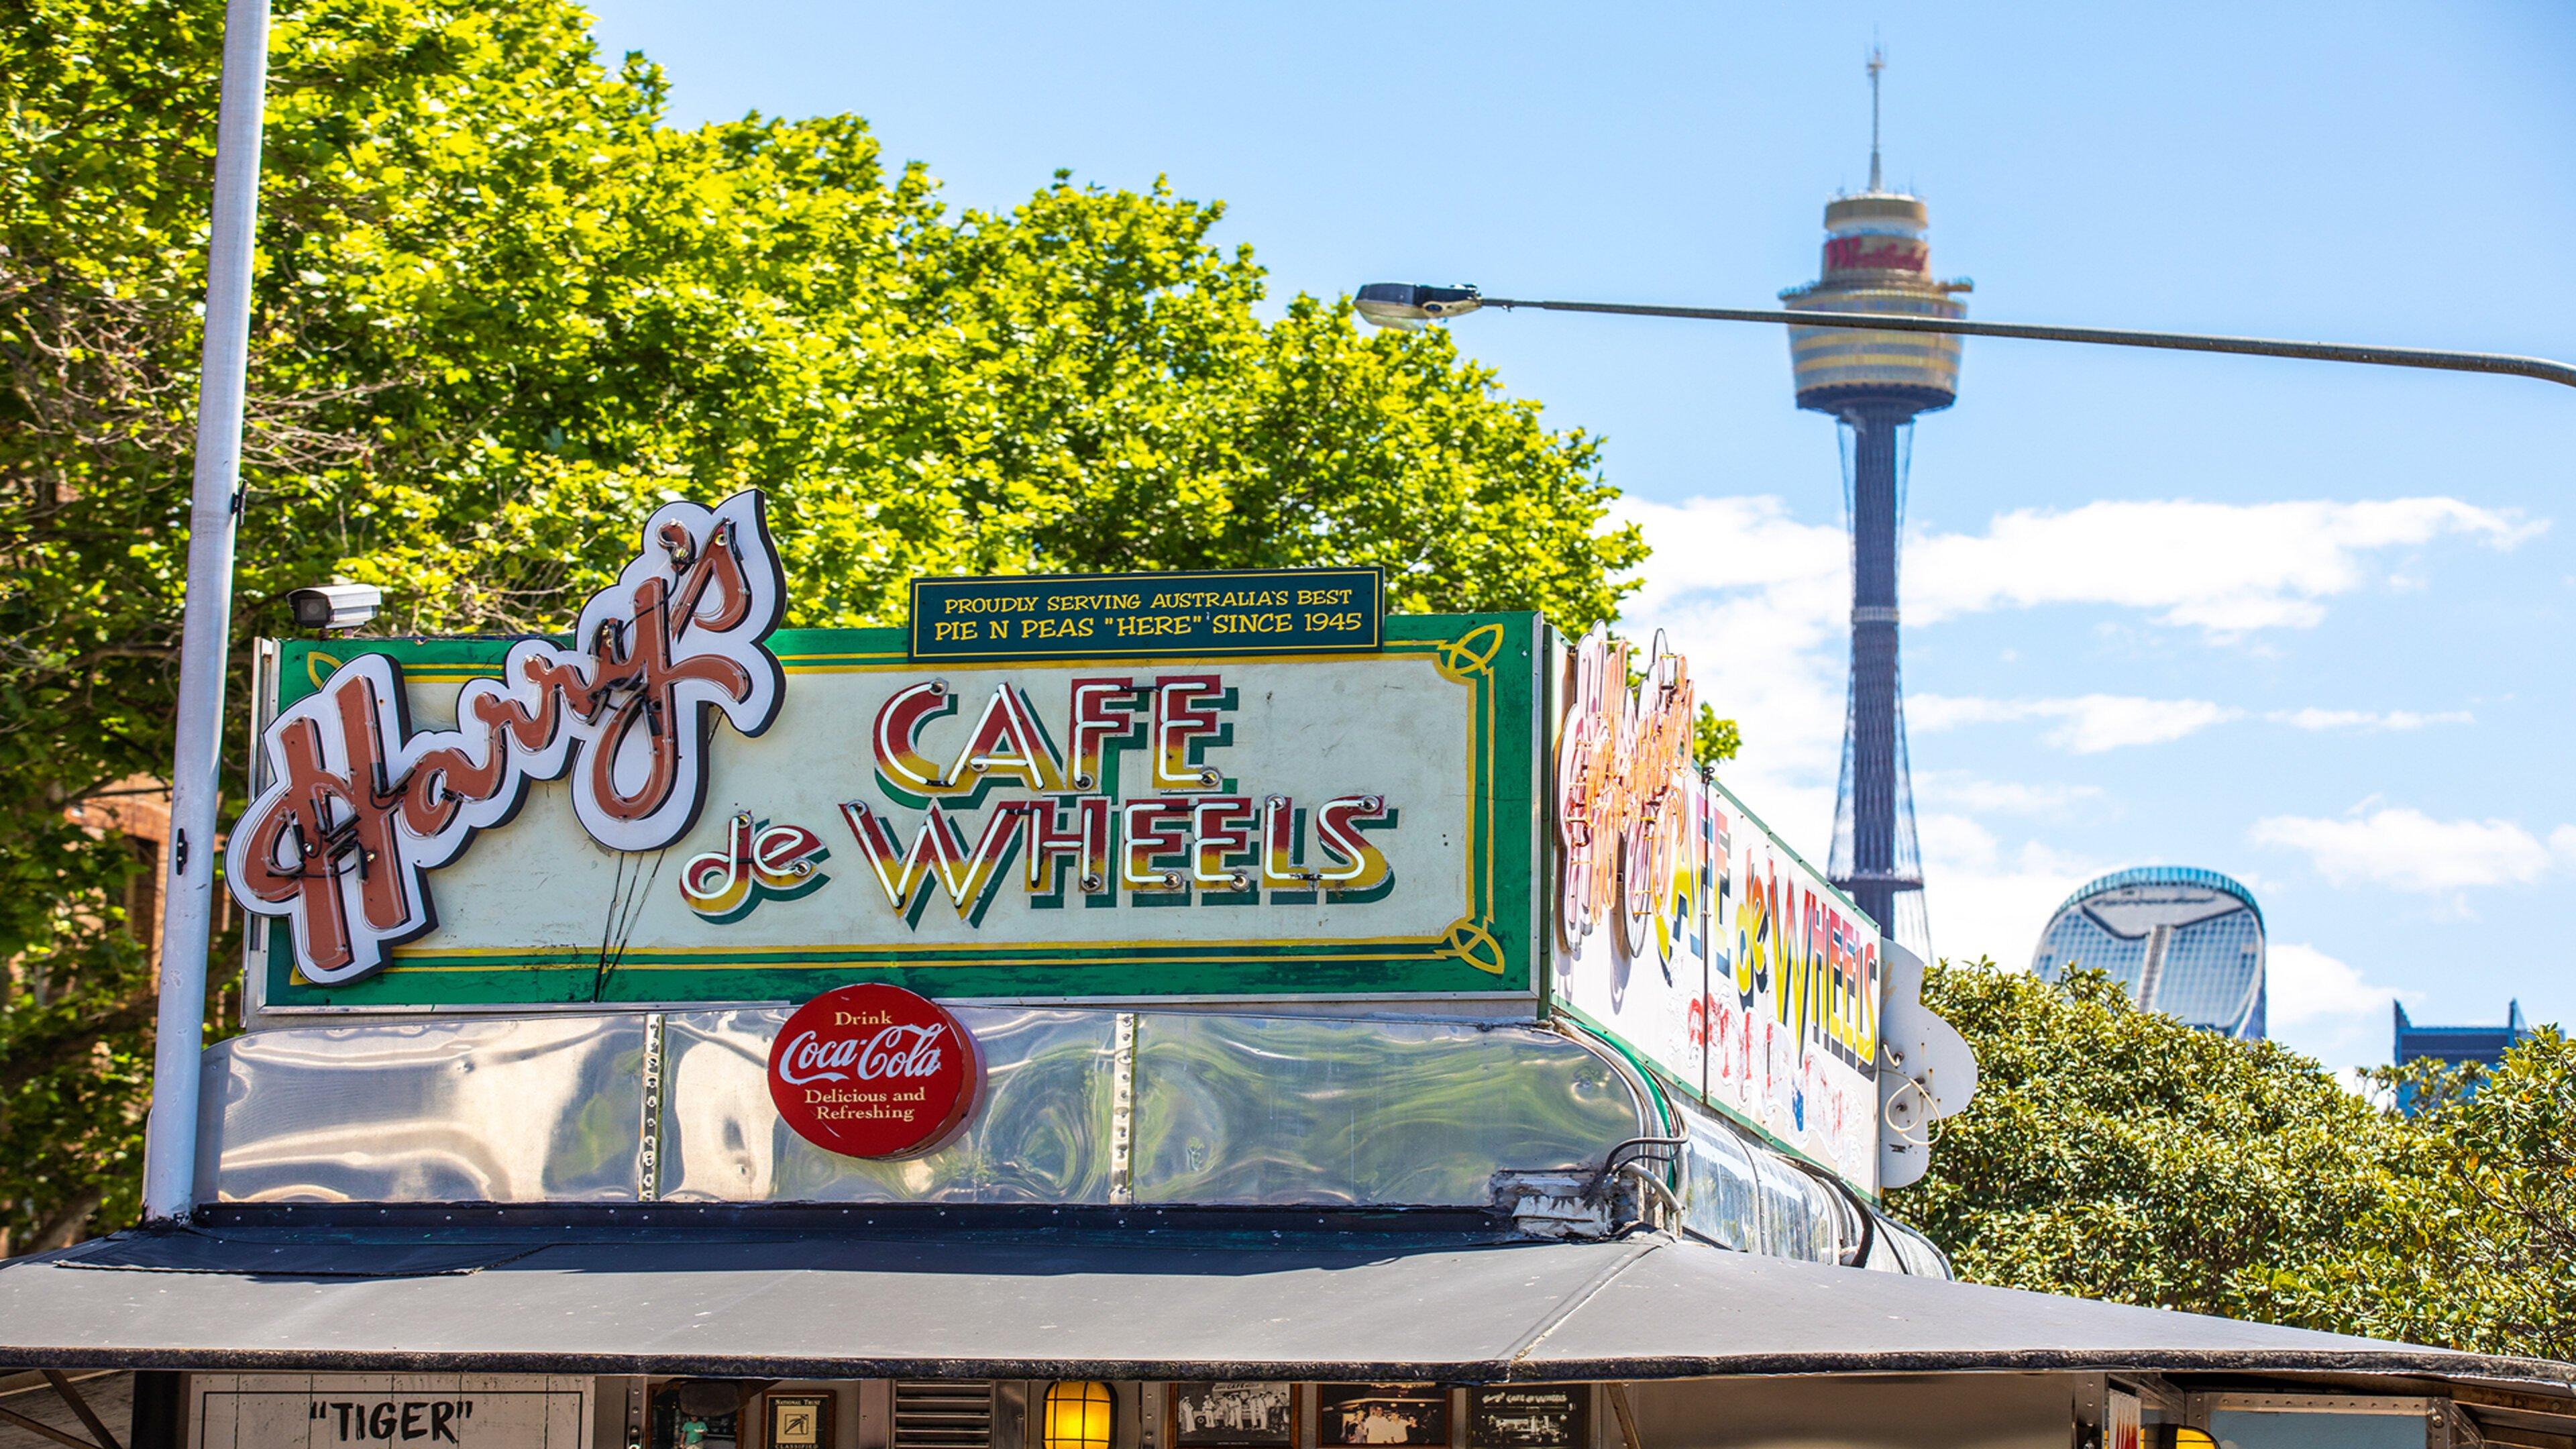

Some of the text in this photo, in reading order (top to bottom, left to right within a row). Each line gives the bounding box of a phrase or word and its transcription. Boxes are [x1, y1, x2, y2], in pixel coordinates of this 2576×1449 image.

[944, 596, 1039, 614] PROUDLY
[1046, 594, 1141, 612] SERVING
[1297, 589, 1353, 605] BEST
[934, 612, 1362, 641] PIE N PEAS "HERE" SINCE 1945
[238, 513, 755, 973] Harry's
[873, 674, 1232, 802] CAFE
[679, 794, 1394, 924] de WHEELS
[1767, 857, 1877, 1072] WHEELS
[835, 1010, 893, 1026] Drink
[779, 1022, 947, 1085] Coca-Cola
[804, 1087, 926, 1104] Delicious and
[816, 1104, 915, 1122] Refreshing
[310, 1401, 473, 1444] "TIGER"
